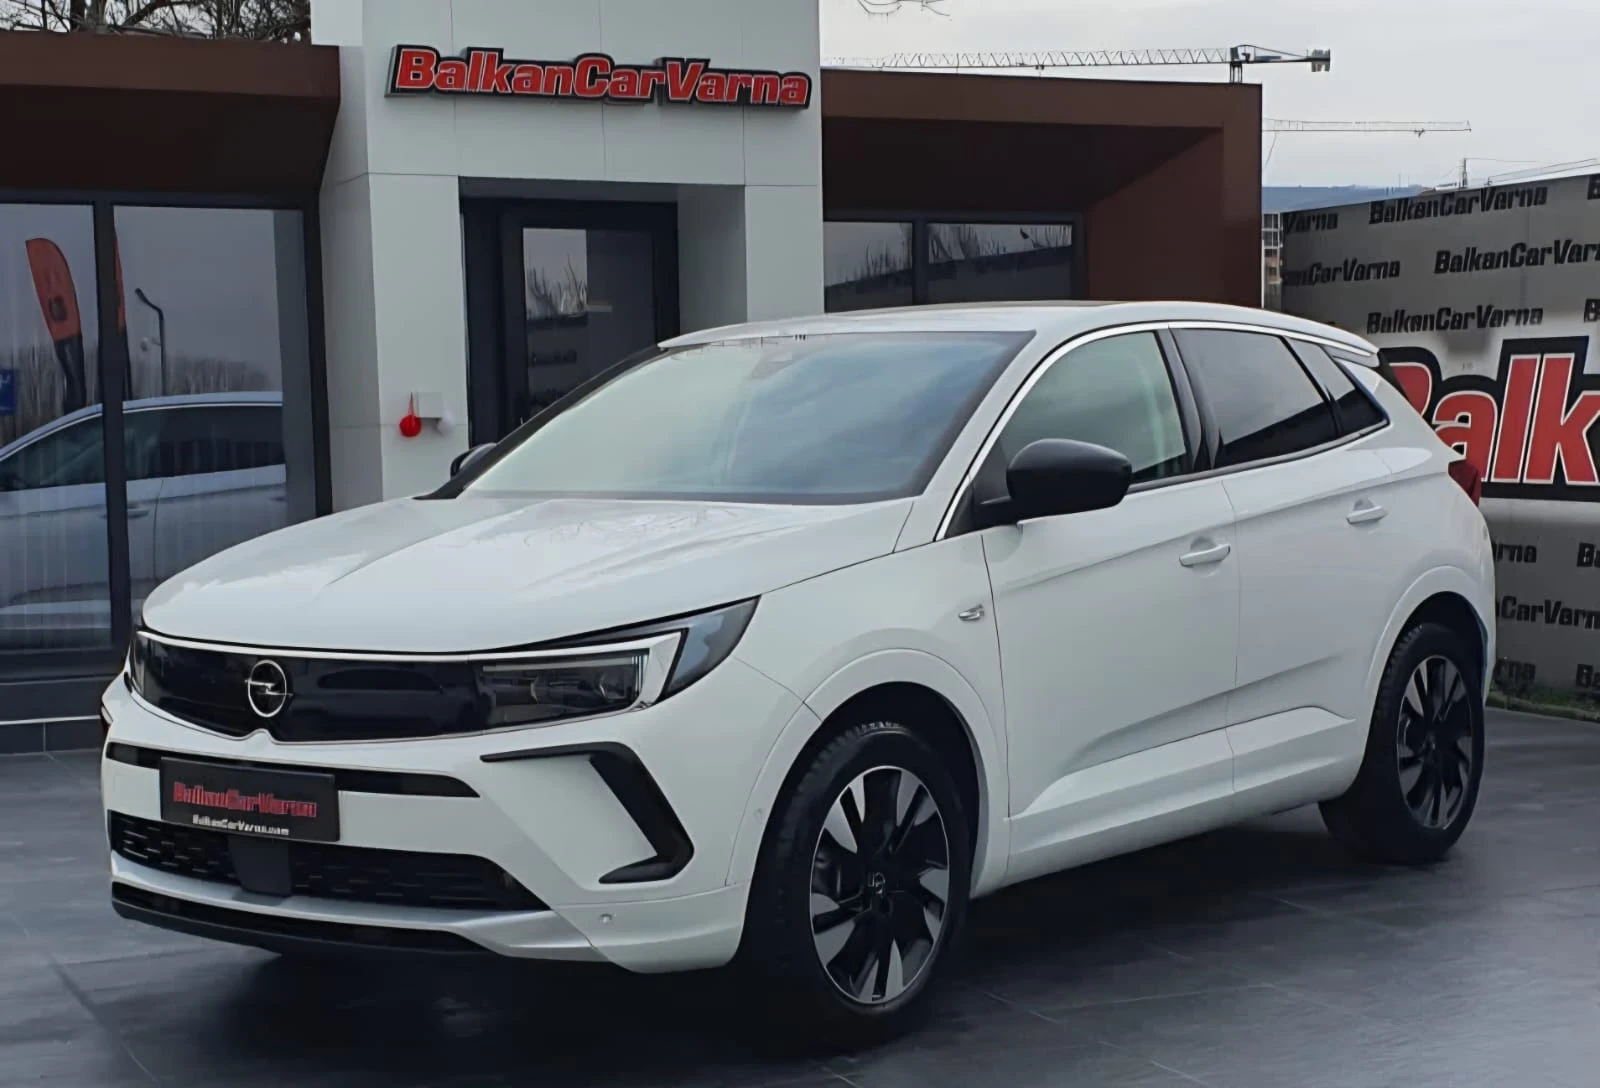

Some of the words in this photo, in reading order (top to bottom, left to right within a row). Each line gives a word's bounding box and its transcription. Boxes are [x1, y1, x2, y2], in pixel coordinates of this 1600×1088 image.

[395, 46, 810, 105] BalkanCarVarna
[1369, 186, 1548, 225] BalkanCarVarna
[1367, 304, 1543, 334] BalkanCarVarna
[1496, 595, 1600, 629] CarVarn
[173, 781, 317, 818] BalkanCarVarna
